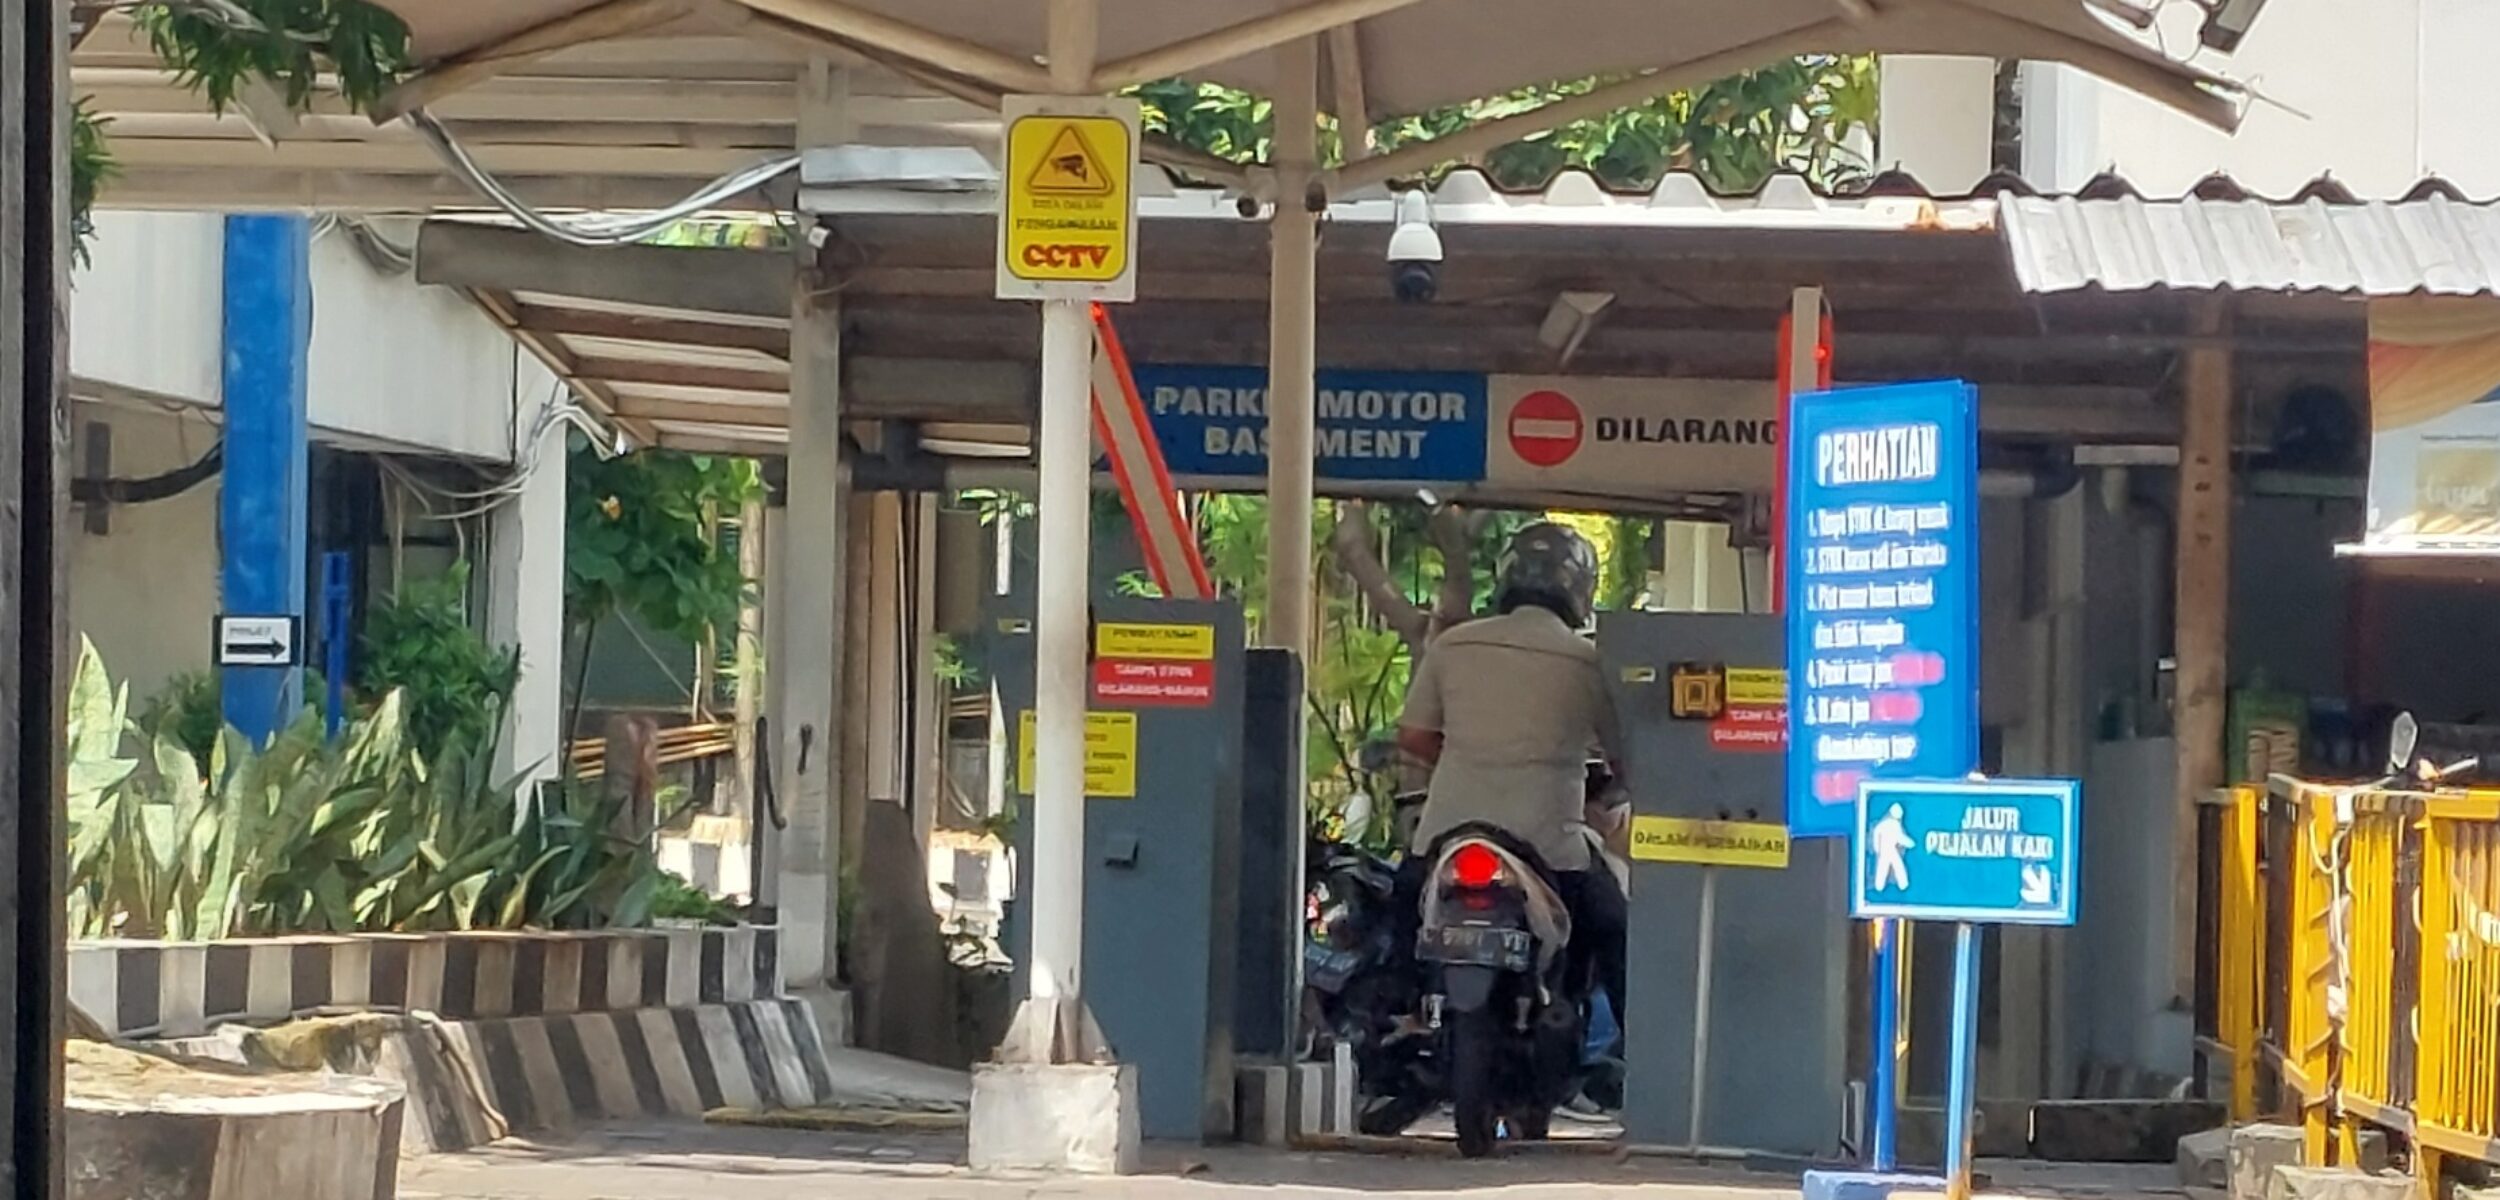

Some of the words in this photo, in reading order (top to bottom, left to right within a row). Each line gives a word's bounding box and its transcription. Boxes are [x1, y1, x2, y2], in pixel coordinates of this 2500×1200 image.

[1023, 244, 1111, 268] CCTV
[1154, 386, 1269, 418] PARKI
[1318, 389, 1466, 421] MOTOR
[1204, 426, 1427, 459] BAMENT
[1596, 417, 1778, 445] DILARANG
[1818, 425, 1937, 487] PERHATIAN
[1961, 806, 2019, 831] JALUR
[1925, 831, 2006, 857] PEJALAN
[2010, 835, 2055, 860] KAKI
